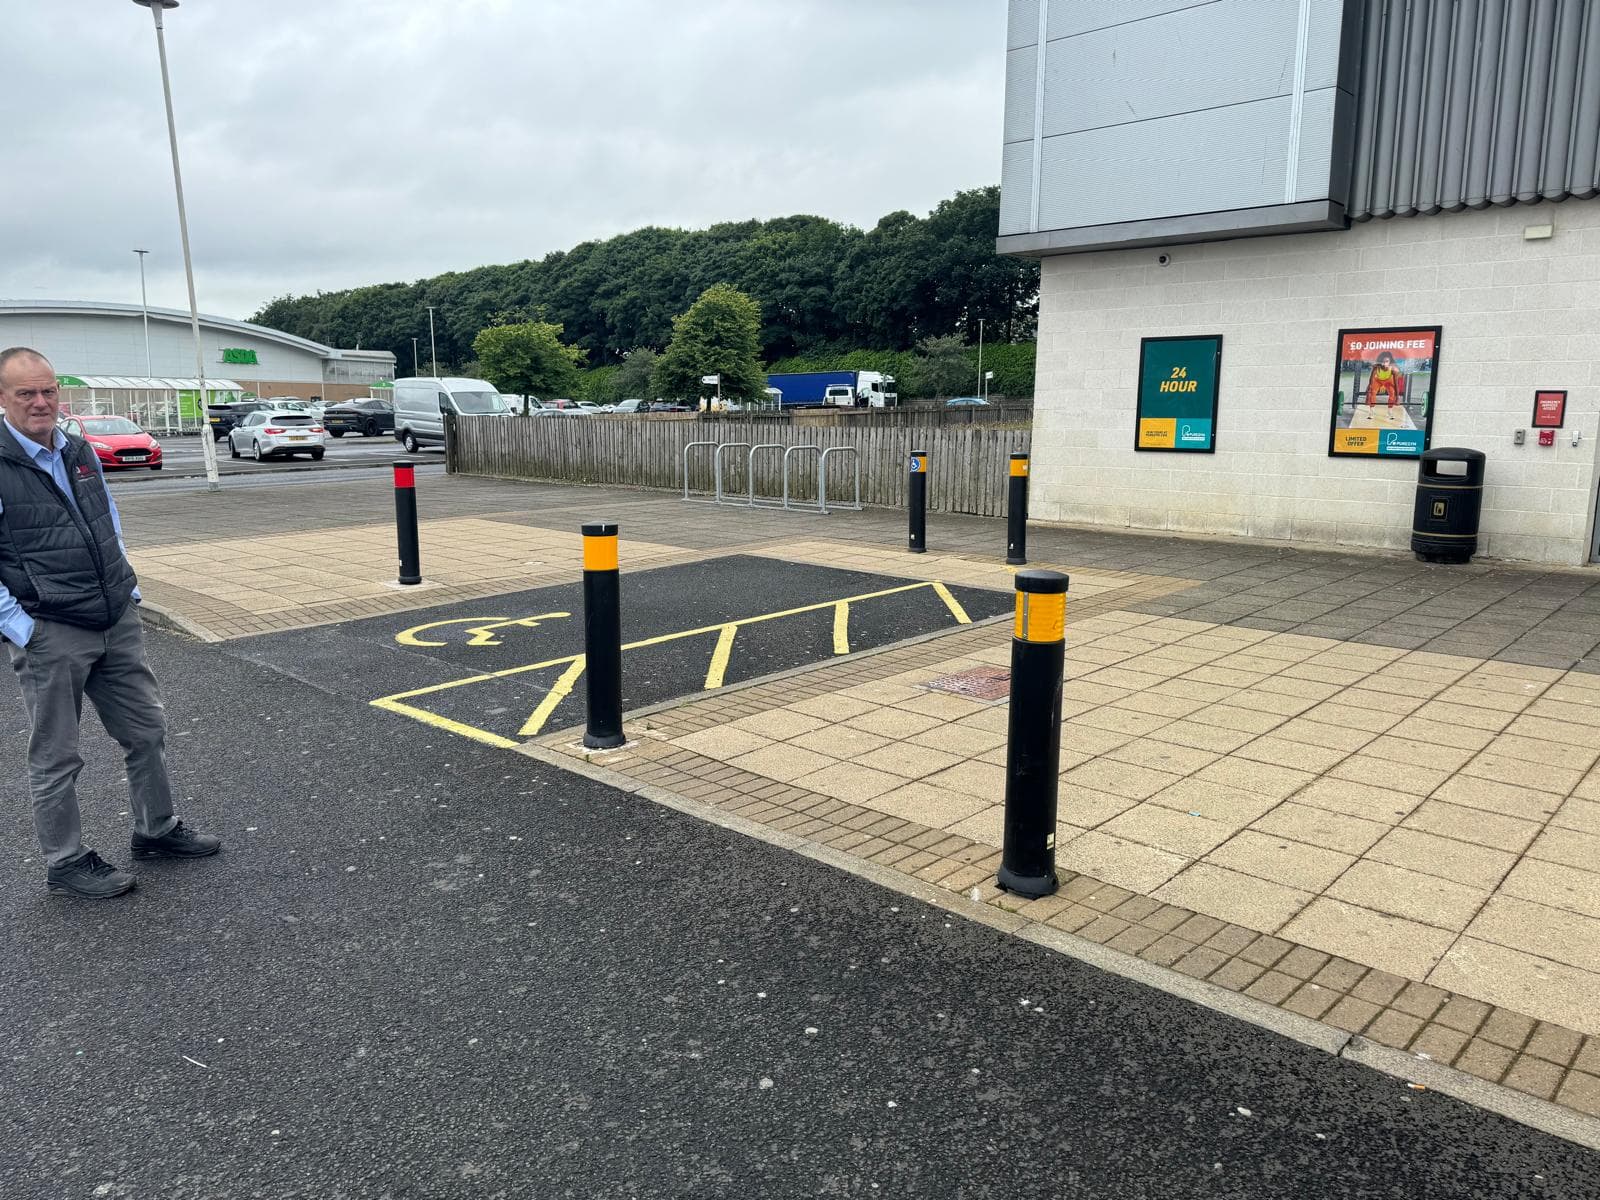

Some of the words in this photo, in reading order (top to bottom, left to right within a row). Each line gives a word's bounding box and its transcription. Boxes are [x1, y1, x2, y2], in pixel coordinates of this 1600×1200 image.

[1350, 343, 1362, 351] £0
[1364, 341, 1404, 350] JOINING
[1406, 339, 1426, 349] FEE
[223, 348, 257, 364] ASDA
[1171, 367, 1187, 378] 24
[1160, 381, 1198, 392] HOUR
